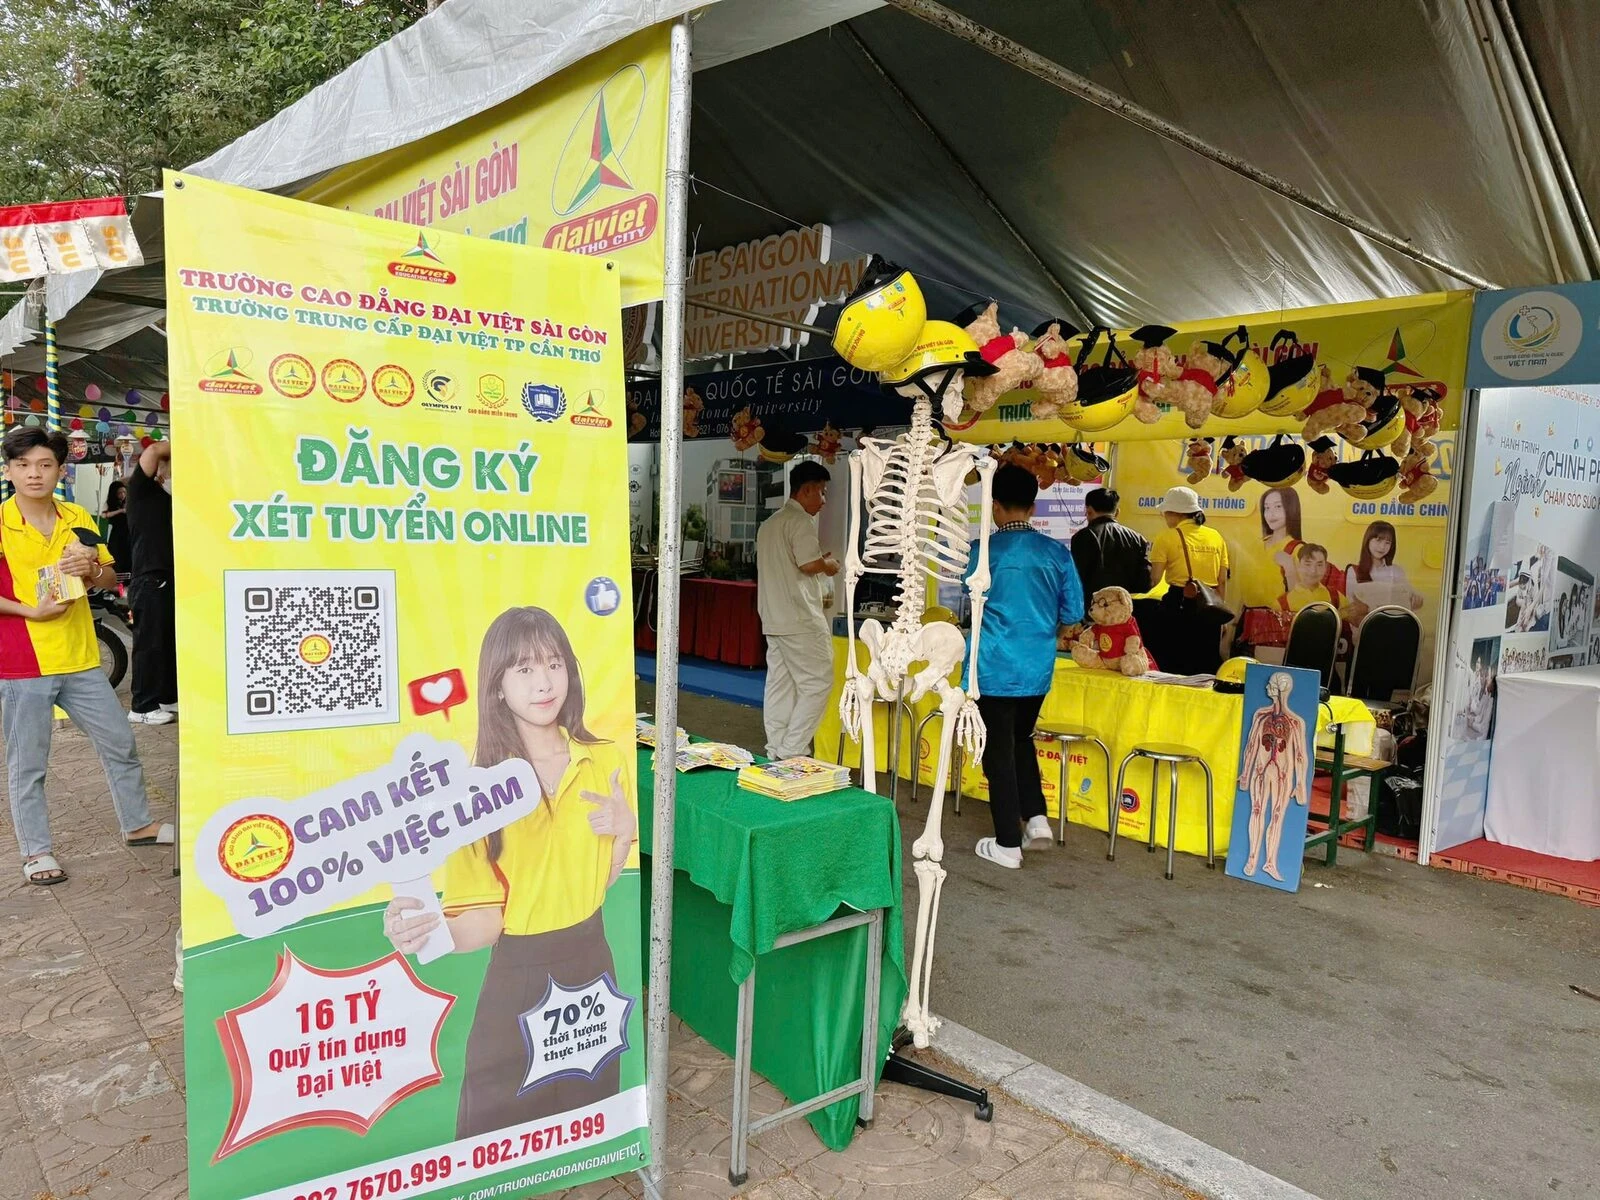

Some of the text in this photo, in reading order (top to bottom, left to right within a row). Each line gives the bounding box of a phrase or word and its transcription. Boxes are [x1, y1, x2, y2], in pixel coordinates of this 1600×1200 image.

[440, 161, 471, 219] SÀI
[476, 140, 518, 204] GÒN
[554, 200, 649, 250] daiviet
[613, 226, 647, 248] CITY
[394, 263, 451, 280] daiviet
[719, 227, 822, 281] SAIGON
[179, 269, 608, 345] TRƯỜNG CAO ĐẲNG ĐẠI VIỆT SÀI GÒN
[687, 259, 865, 322] TERNATIONAL
[192, 296, 601, 363] TRƯỜNG TRUNG CẤP ĐẠI VIỆT TP CẦN THƠ
[685, 309, 806, 356] NIVERSITY
[706, 374, 757, 401] QUỐC
[765, 367, 787, 395] TẾ
[791, 367, 822, 392] SÀI
[297, 428, 538, 493] ĐĂNG KÝ
[1545, 450, 1586, 481] CHINH
[232, 492, 587, 544] XÉT TUYỂN ONLINE
[1138, 497, 1156, 507] CAO
[1352, 497, 1449, 517] CAO ĐẲNG CHÍN
[294, 751, 450, 844] CAM KẾT
[248, 776, 524, 917] 100% VIỆC LÀM
[296, 979, 381, 1034] 16 TỶ
[543, 992, 605, 1035] 70%
[269, 1027, 407, 1073] Quỹ tín dụng
[543, 1021, 607, 1048] thời lượng
[544, 1034, 607, 1062] thực hành
[297, 1059, 382, 1098] Đại Việt
[294, 1155, 451, 1200] 27670.999
[472, 1112, 606, 1169] 082.7671.999
[450, 1141, 641, 1200] COM/TRUONGCAODANGDAIVIETCT
